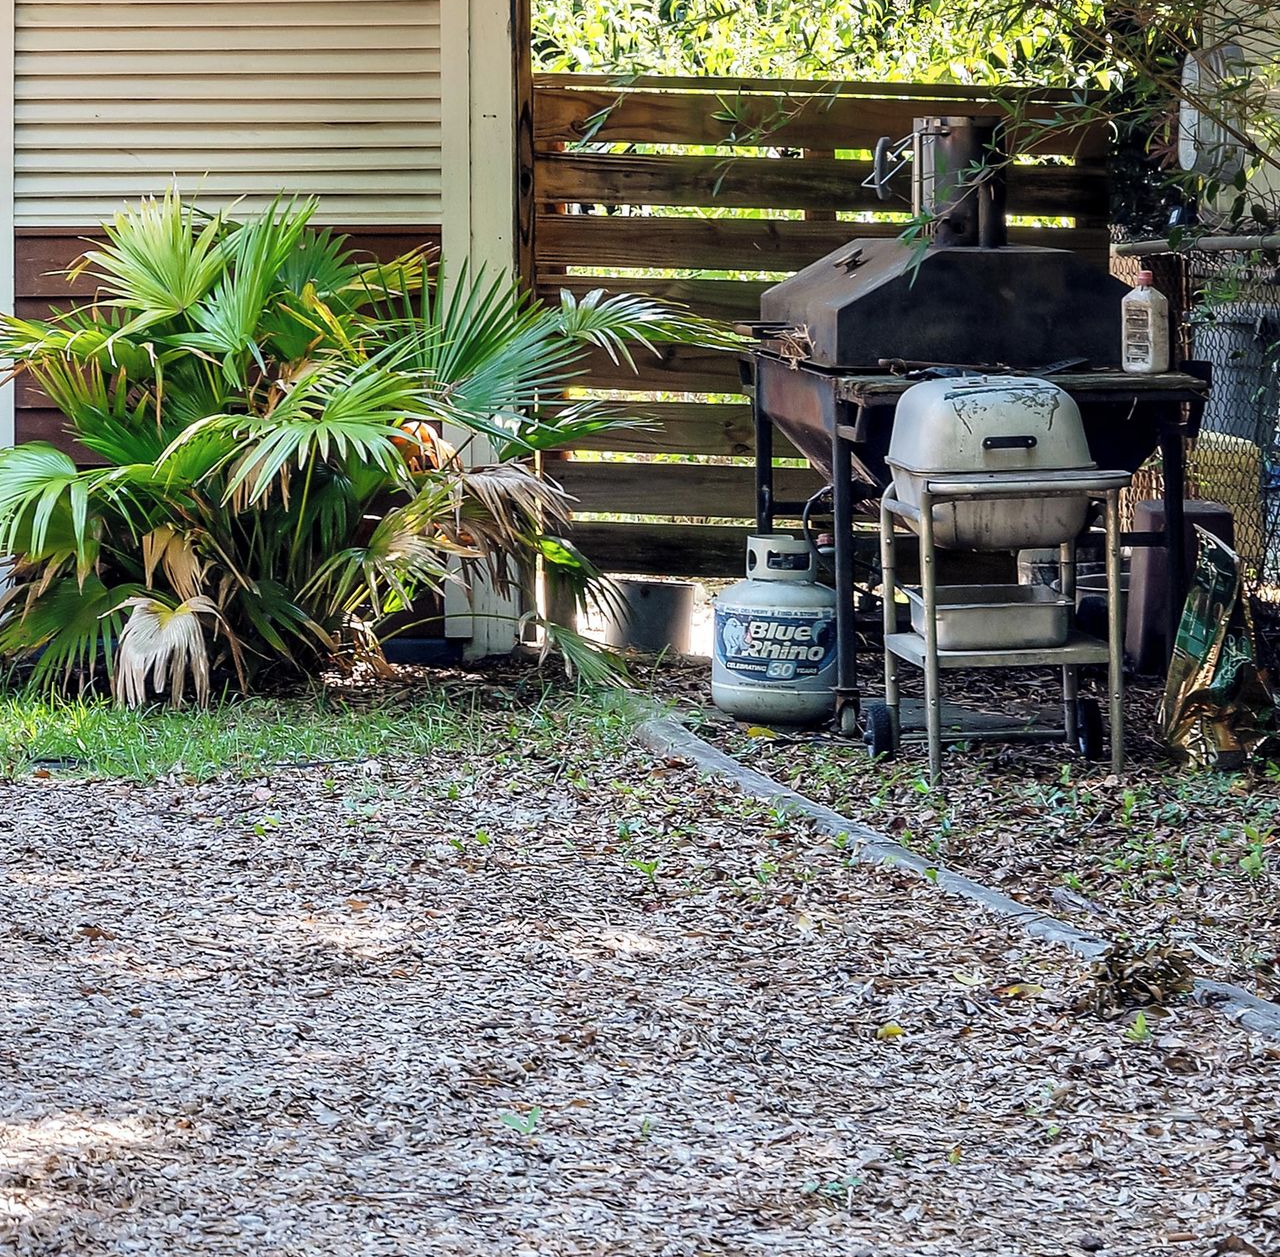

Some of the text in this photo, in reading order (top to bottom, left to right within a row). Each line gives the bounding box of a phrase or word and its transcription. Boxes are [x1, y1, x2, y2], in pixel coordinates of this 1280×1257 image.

[748, 621, 813, 641] Blue
[742, 640, 825, 661] Rhino
[726, 661, 768, 672] CELEBRATING
[768, 662, 794, 677] 30
